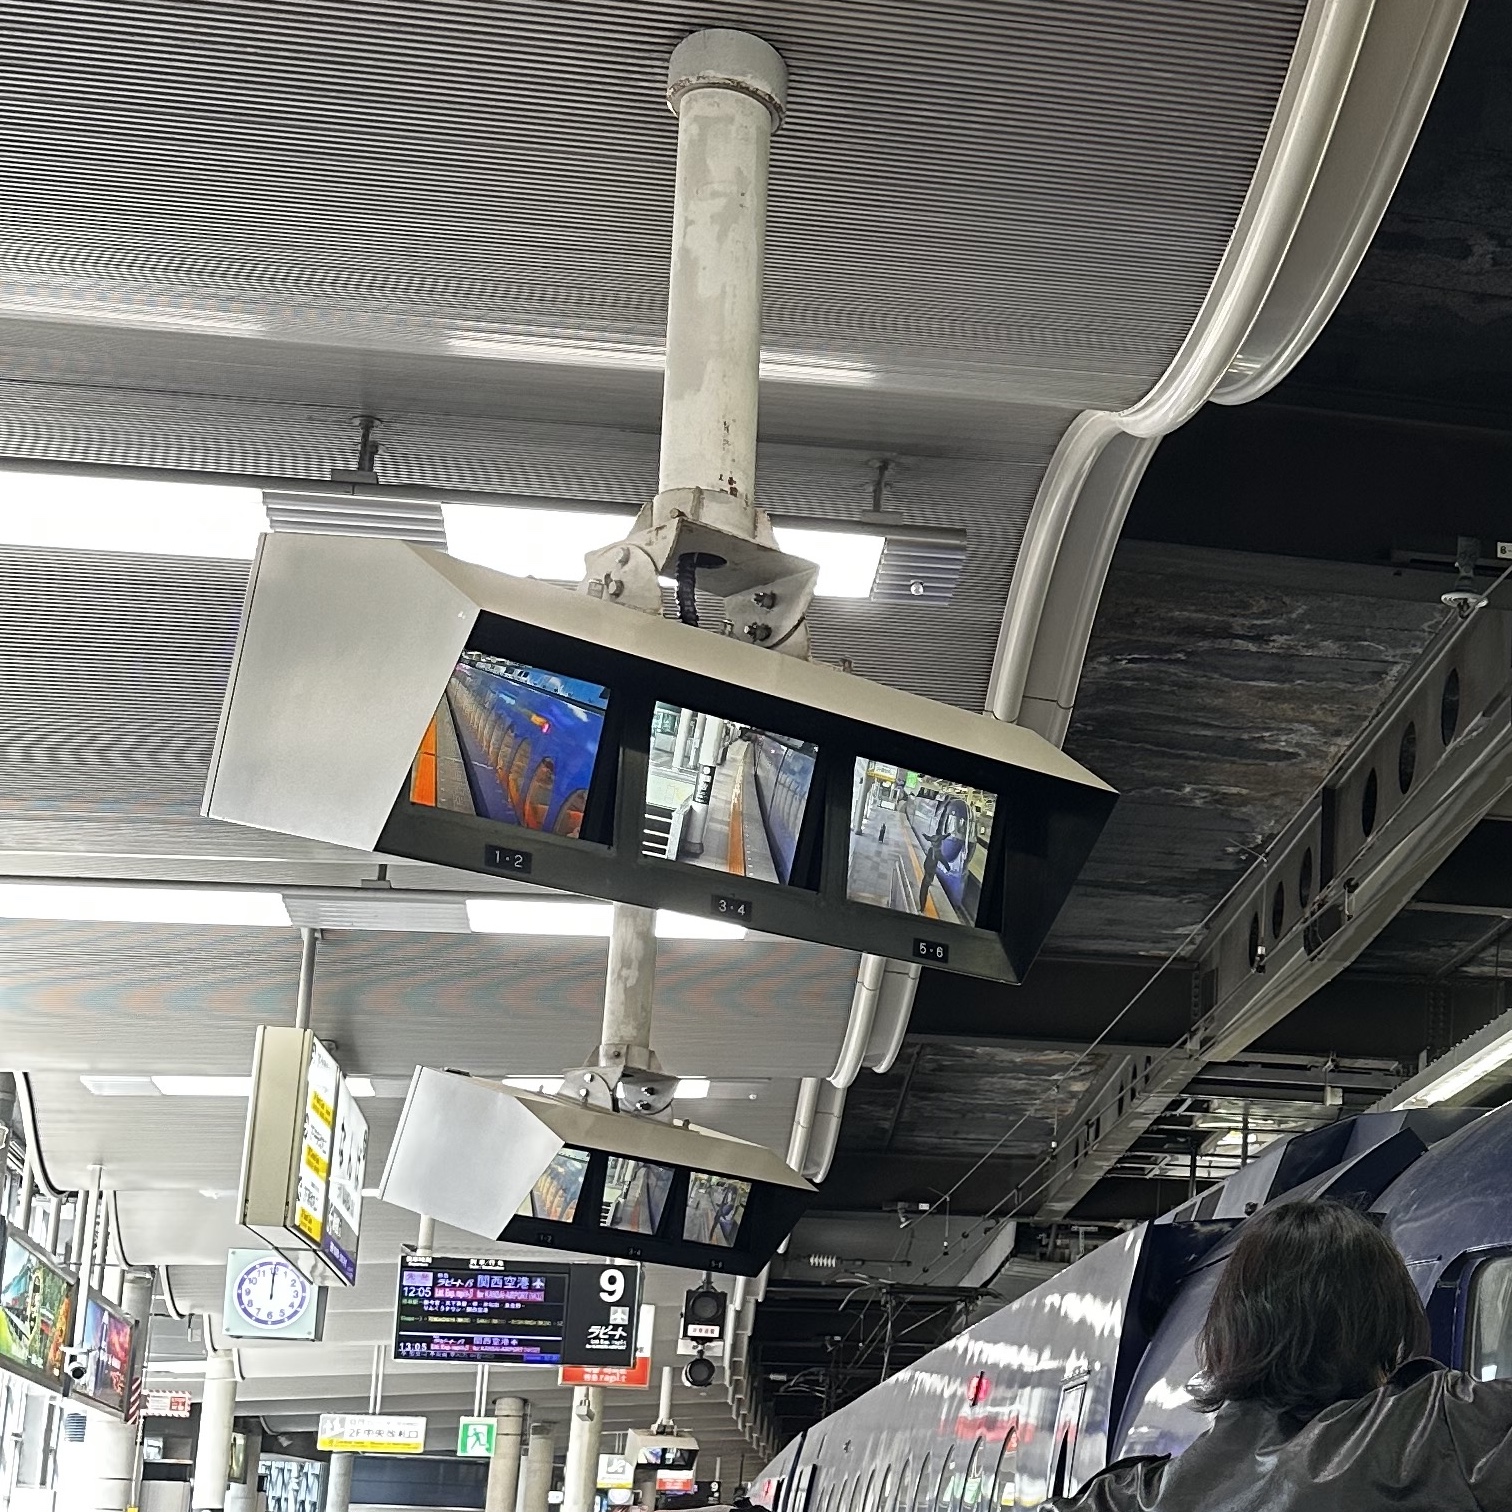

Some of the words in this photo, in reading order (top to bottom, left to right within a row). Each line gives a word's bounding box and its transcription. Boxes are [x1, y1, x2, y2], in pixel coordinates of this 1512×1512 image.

[257, 1269, 266, 1277] 11
[248, 1276, 257, 1285] 10
[291, 1279, 296, 1287] 2
[477, 1275, 530, 1289] 関西空港
[600, 1269, 625, 1302] 9
[245, 1288, 251, 1296] 9
[293, 1290, 298, 1298] 3
[403, 1287, 432, 1298] 12:05
[256, 1308, 261, 1316] 7
[279, 1309, 285, 1317] 5
[399, 1342, 427, 1351] 13:05
